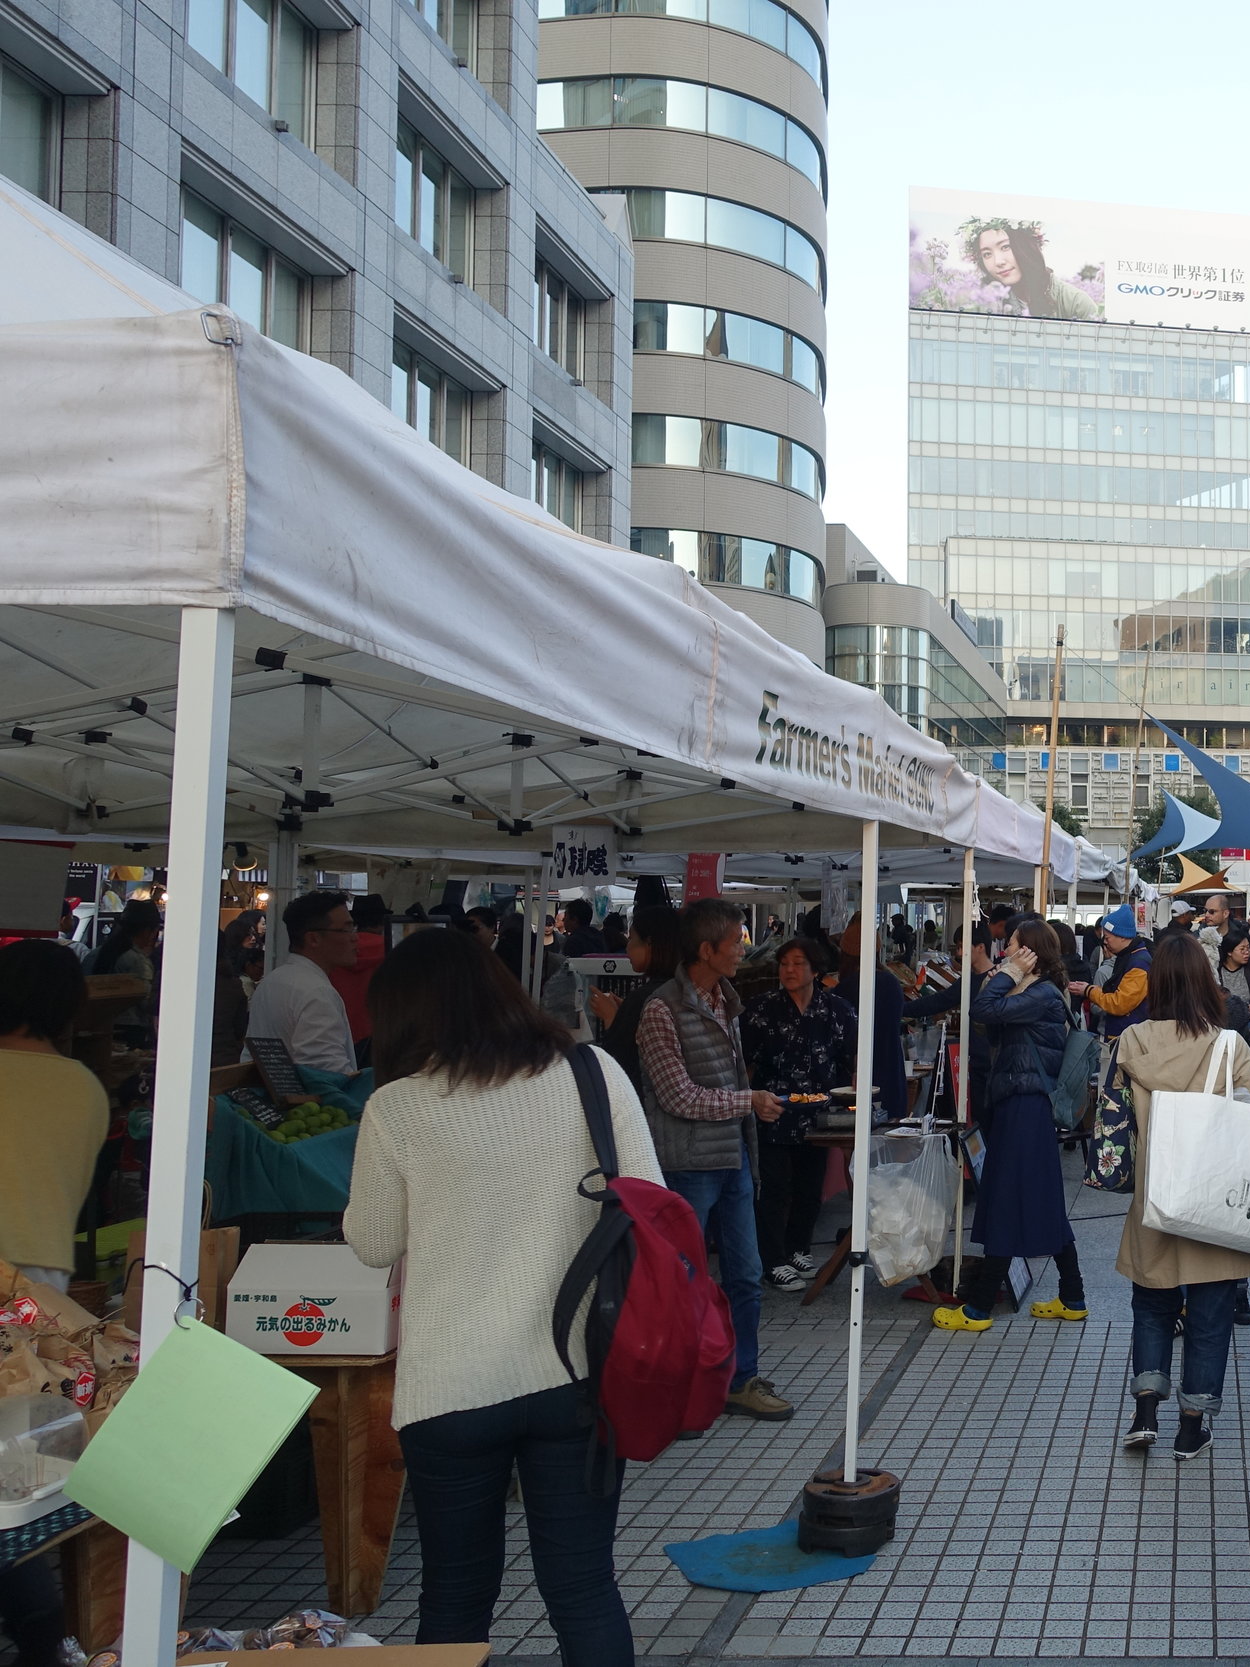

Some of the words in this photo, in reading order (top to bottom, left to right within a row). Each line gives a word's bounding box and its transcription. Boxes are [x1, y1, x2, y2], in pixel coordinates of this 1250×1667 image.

[1173, 264, 1245, 284] 世界第1位
[1117, 283, 1246, 302] GMOクリック証券
[755, 690, 851, 789] Farmer's
[256, 1315, 351, 1333] 元気の出るみかん
